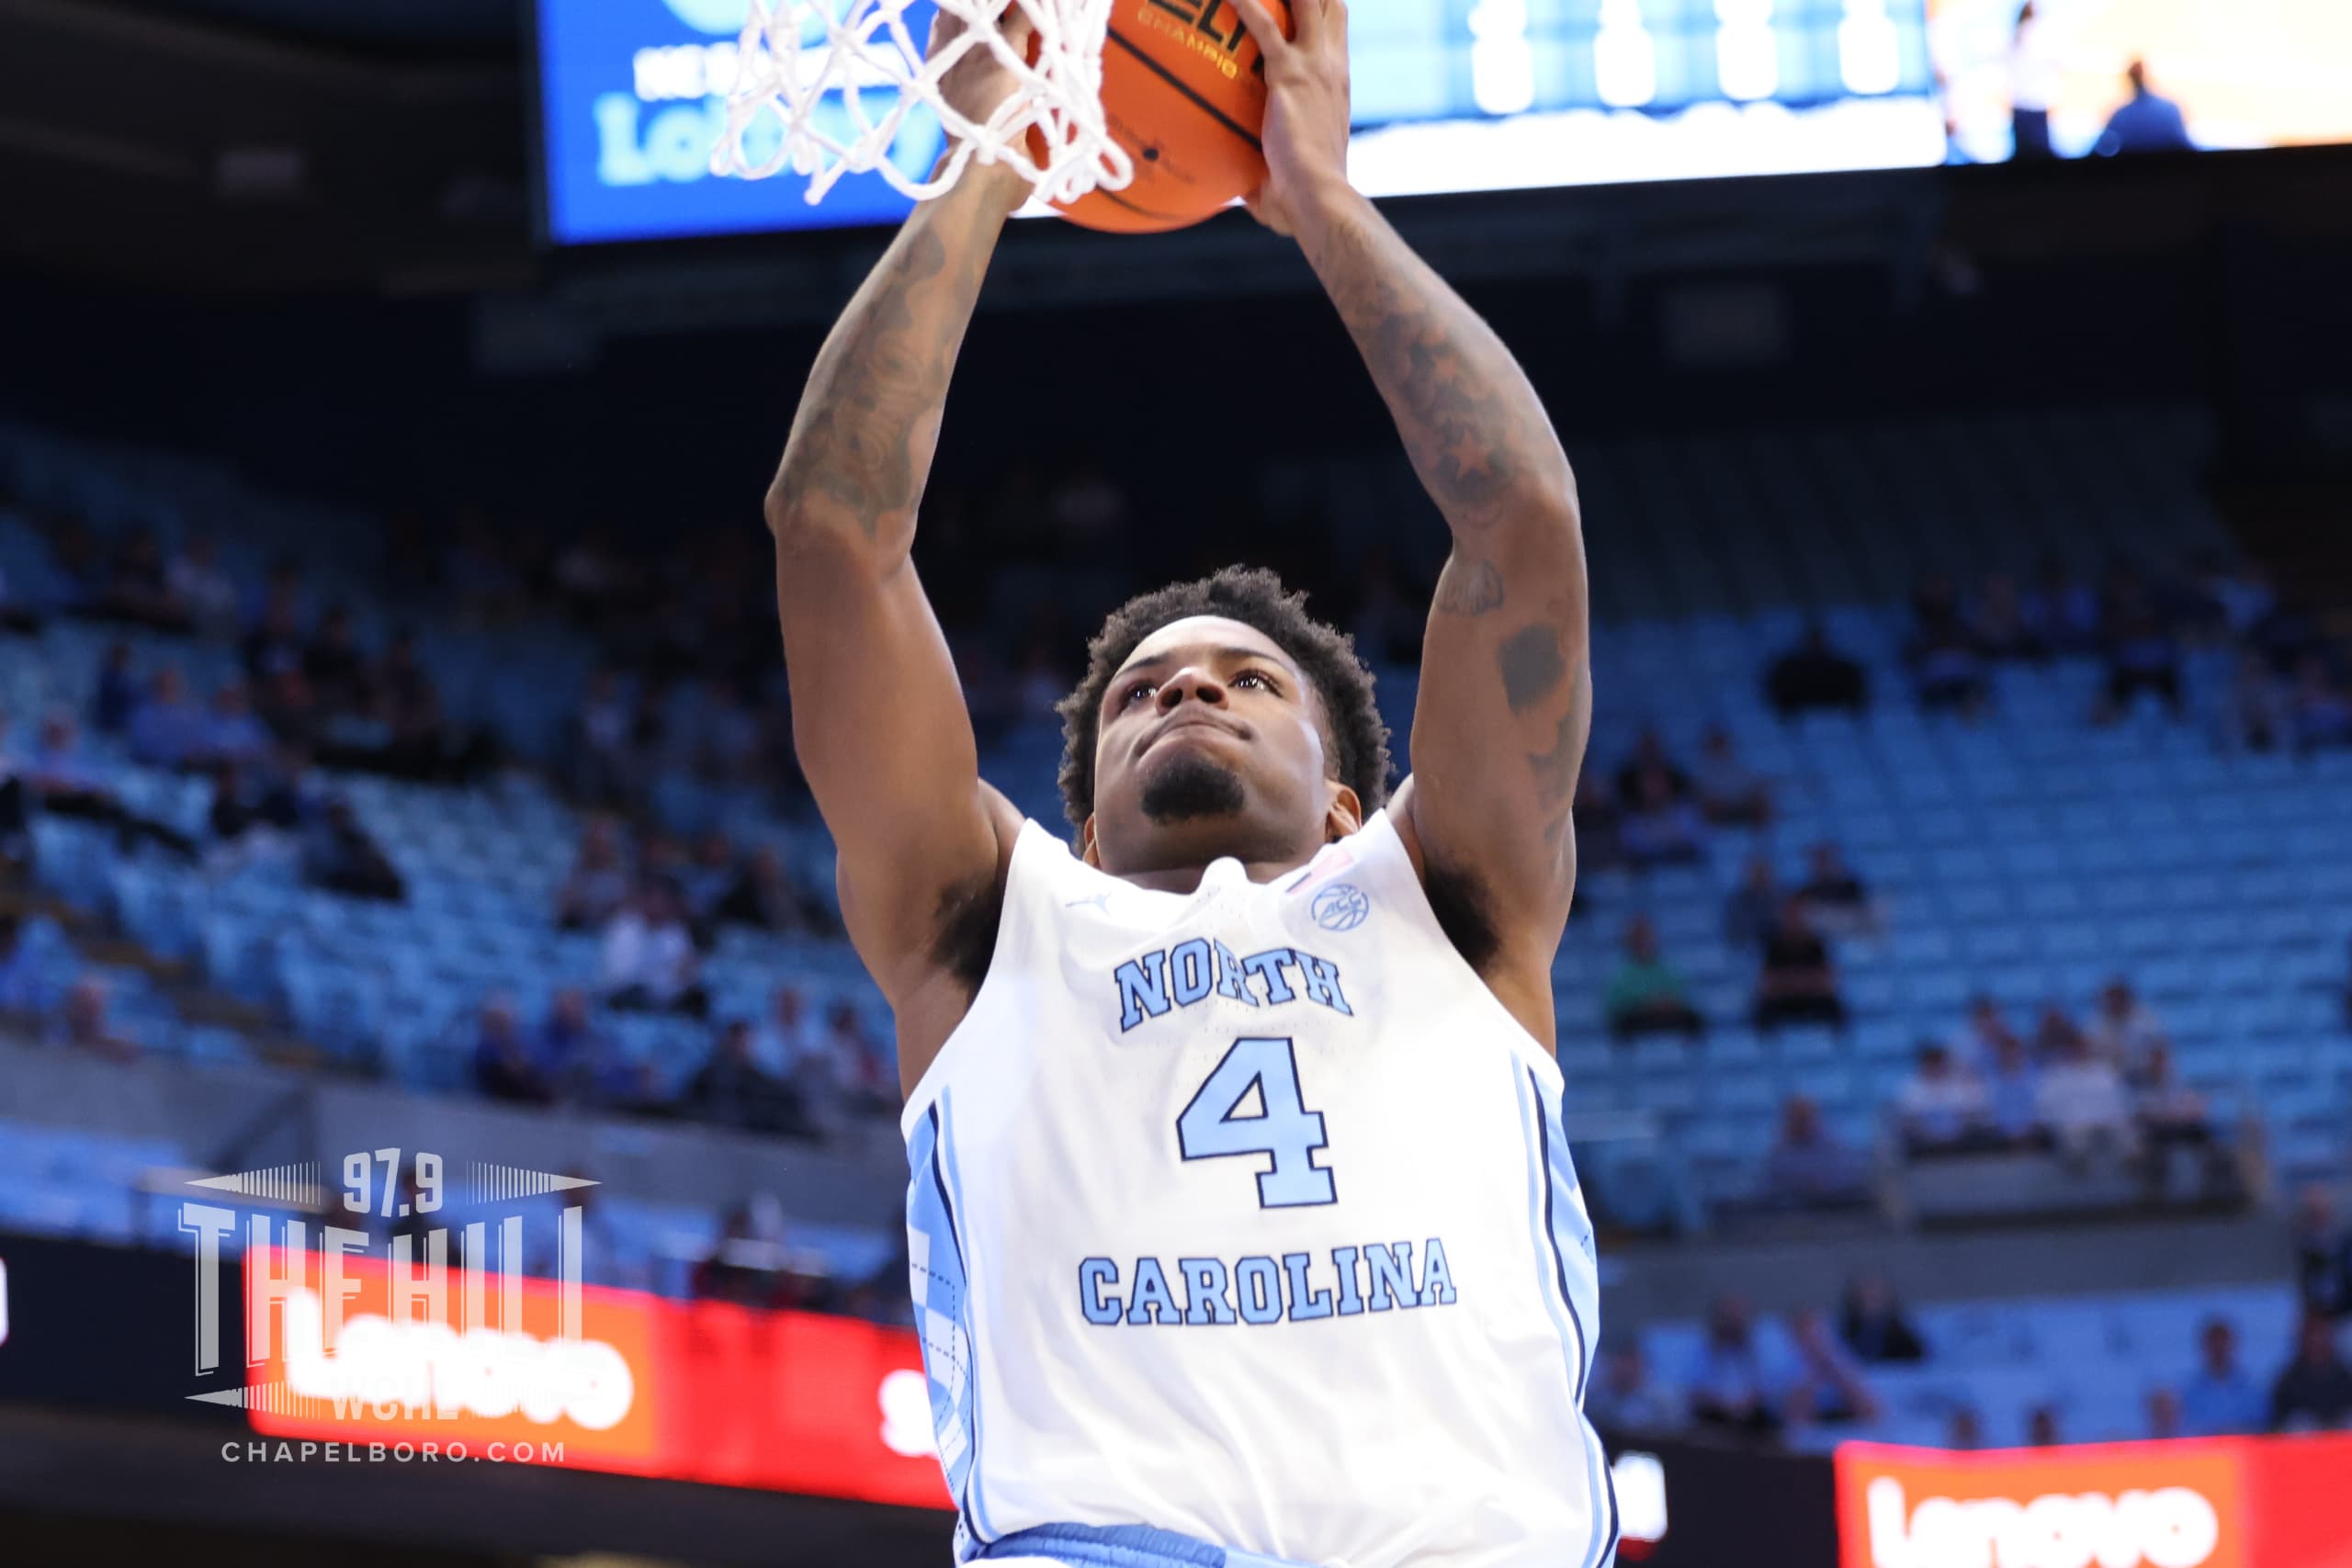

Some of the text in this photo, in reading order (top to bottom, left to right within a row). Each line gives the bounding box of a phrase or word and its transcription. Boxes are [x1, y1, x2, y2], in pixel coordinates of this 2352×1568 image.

[1114, 937, 1355, 1033] NORTH
[1176, 1036, 1339, 1209] 4
[1079, 1237, 1457, 1325] CAROLINA
